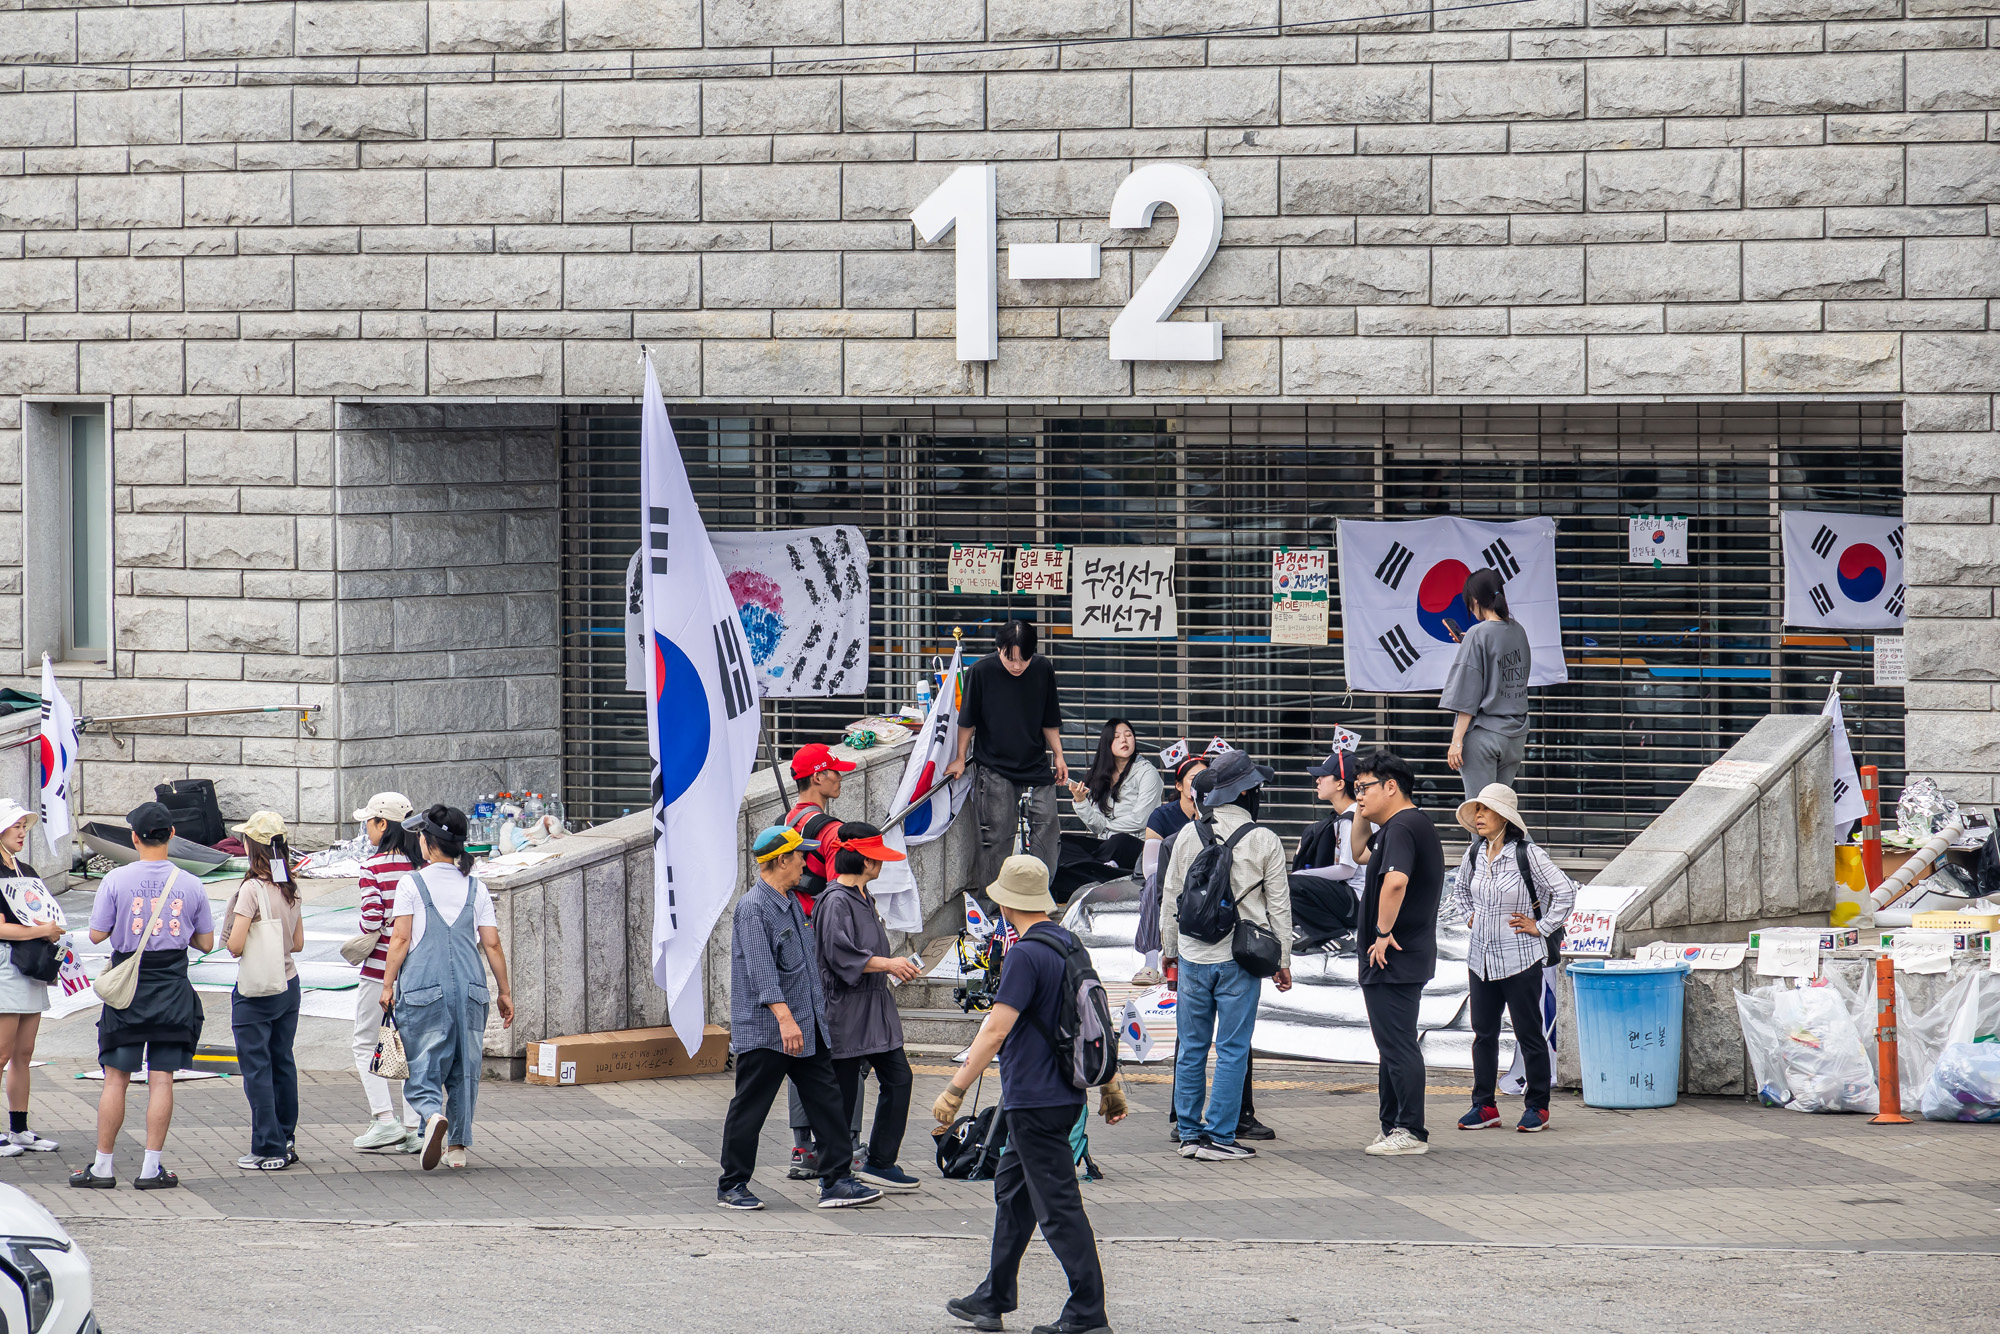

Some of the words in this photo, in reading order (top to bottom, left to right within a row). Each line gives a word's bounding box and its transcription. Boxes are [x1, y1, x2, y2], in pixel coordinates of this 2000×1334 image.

[909, 163, 1224, 362] 1-2
[952, 548, 1002, 567] 부정선거
[1020, 551, 1039, 568] 당일
[1044, 551, 1063, 567] 투표
[1274, 552, 1325, 571] 부정선거
[949, 578, 964, 587] STOP
[967, 579, 978, 587] THE
[980, 579, 1000, 588] STEAL
[1081, 558, 1174, 600] 부정선거
[1294, 573, 1328, 590] 재선거
[1273, 601, 1300, 611] 게이트
[1081, 604, 1162, 633] 재선거
[140, 880, 172, 889] CLEA
[130, 889, 157, 898] YOUR
[1628, 1026, 1666, 1049] 핸드볼
[561, 1066, 576, 1079] JP
[596, 1063, 613, 1073] Tent
[614, 1061, 632, 1071] Tarp
